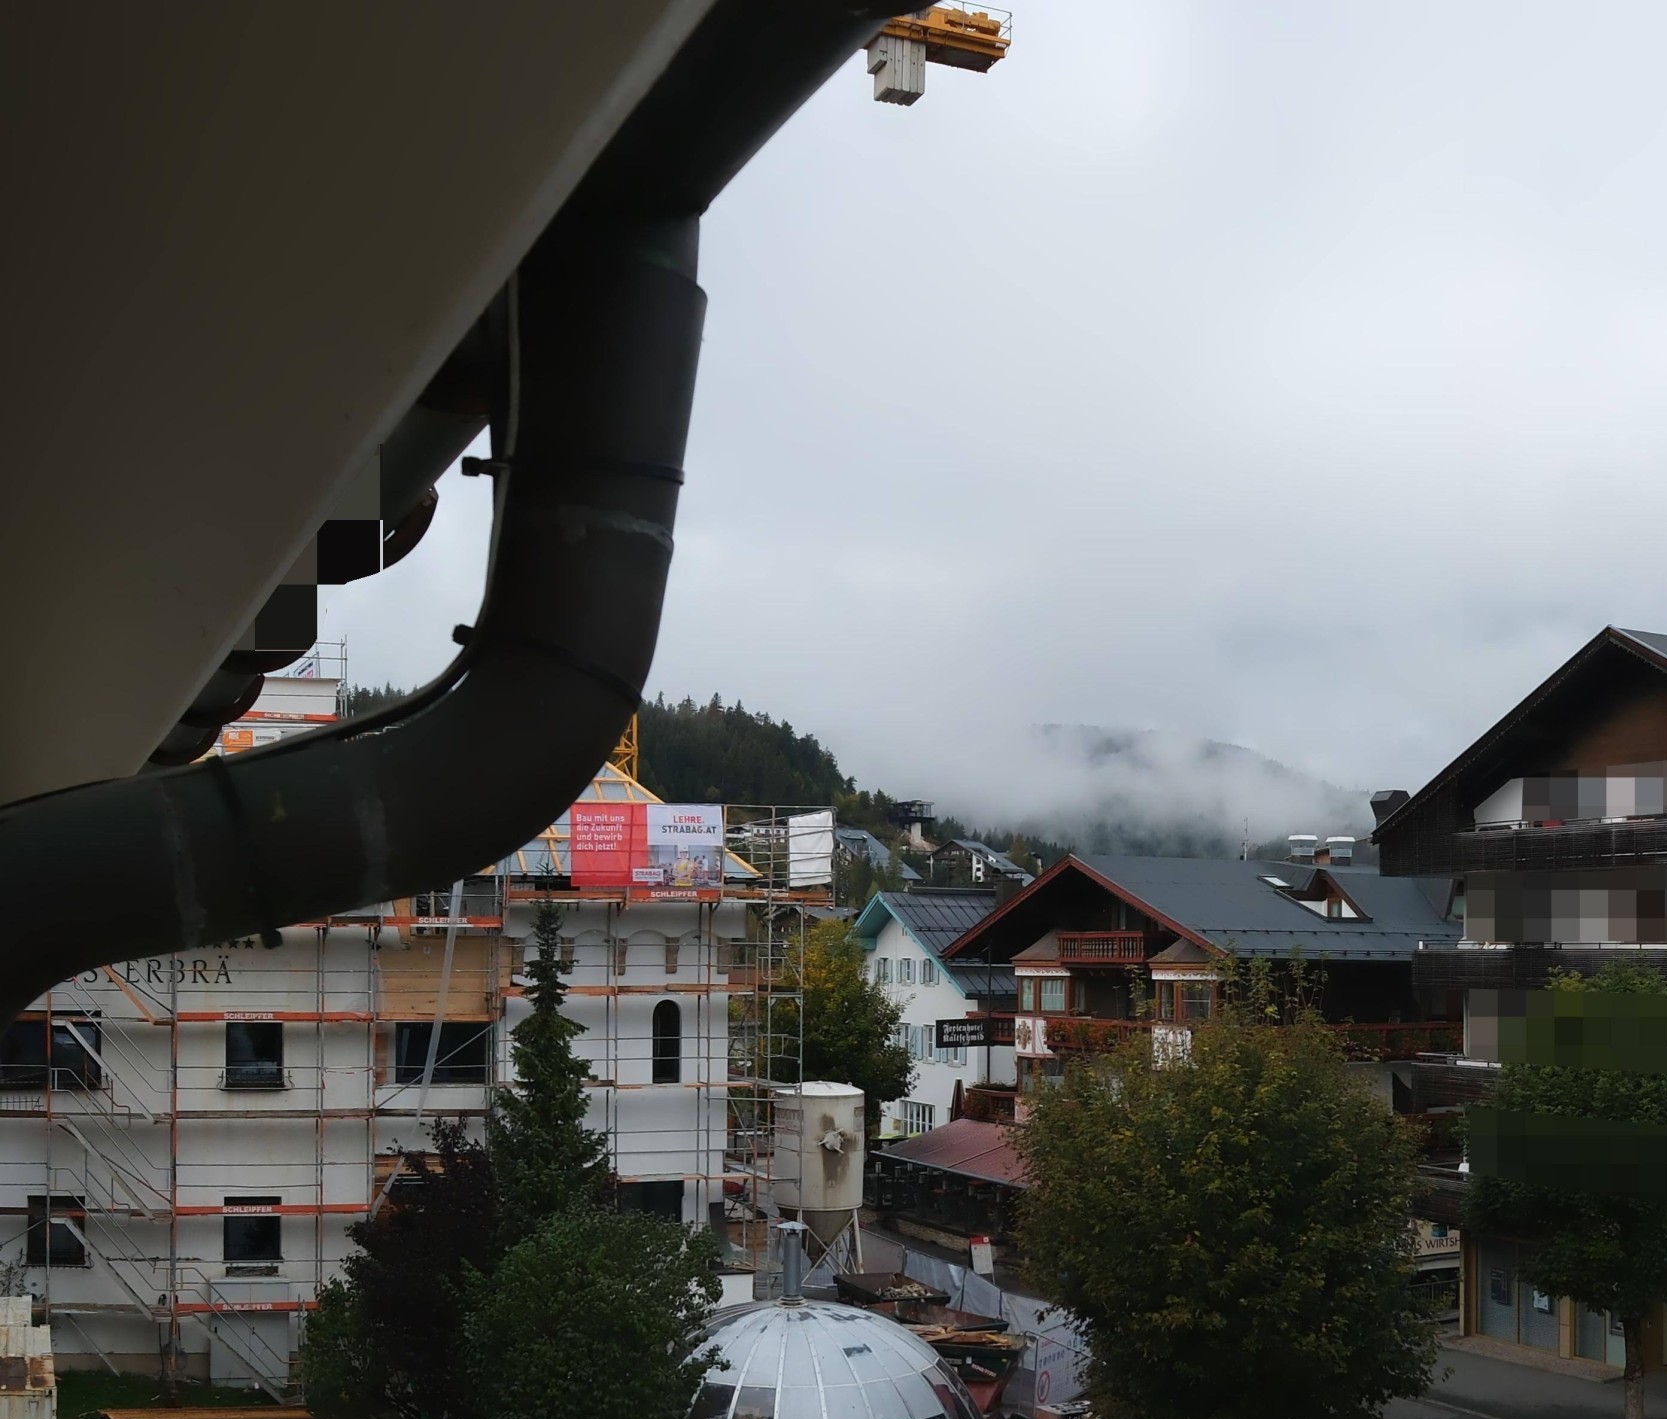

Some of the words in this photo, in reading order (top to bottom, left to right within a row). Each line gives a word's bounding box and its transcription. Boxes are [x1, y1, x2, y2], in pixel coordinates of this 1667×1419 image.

[576, 814, 592, 822] Bau
[594, 814, 608, 822] mit
[673, 815, 704, 824] LEHRE.
[661, 825, 716, 834] STRABAG.AT
[577, 833, 591, 841] und
[594, 833, 622, 841] bewirb
[577, 842, 593, 850] dich
[595, 842, 616, 851] jetzt!
